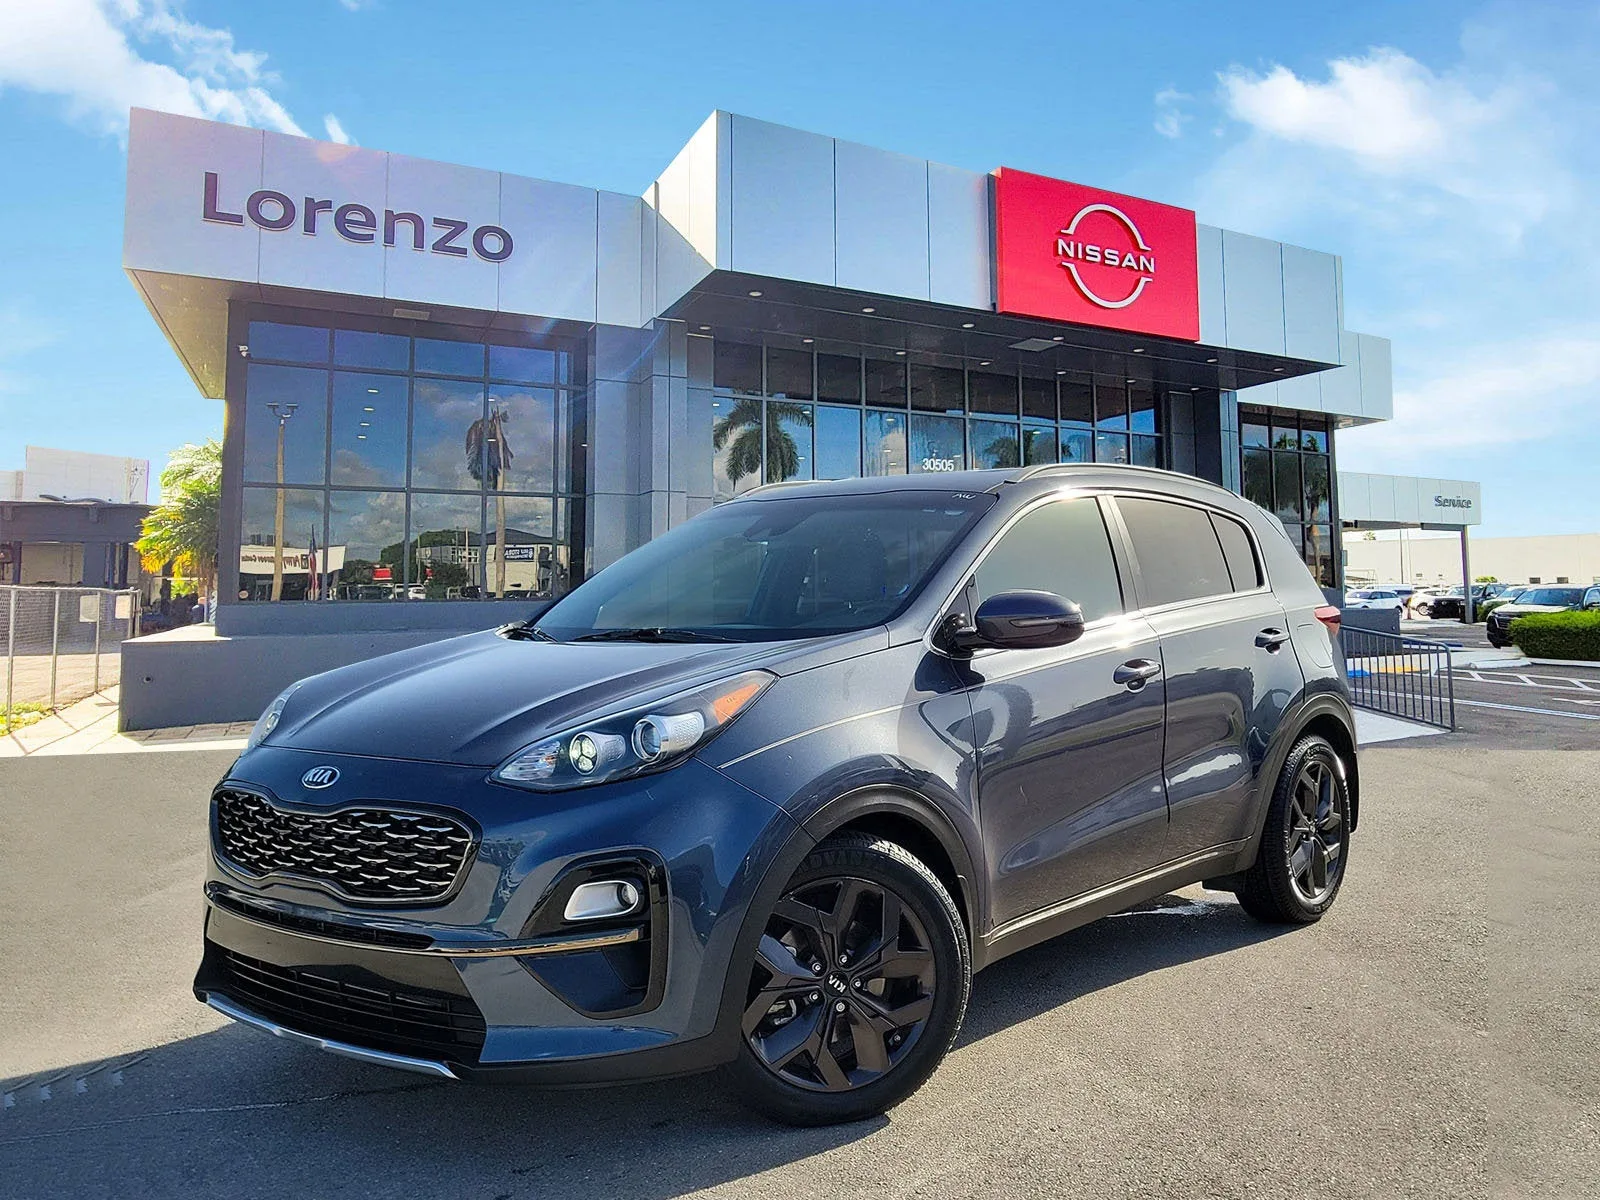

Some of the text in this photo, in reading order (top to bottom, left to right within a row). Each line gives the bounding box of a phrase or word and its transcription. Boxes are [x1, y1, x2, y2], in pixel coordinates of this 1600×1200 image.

[202, 171, 514, 263] Lorenzo
[1057, 238, 1155, 273] NISSAN
[922, 458, 954, 471] 30505
[1434, 495, 1472, 509] Service
[828, 974, 847, 993] KIA
